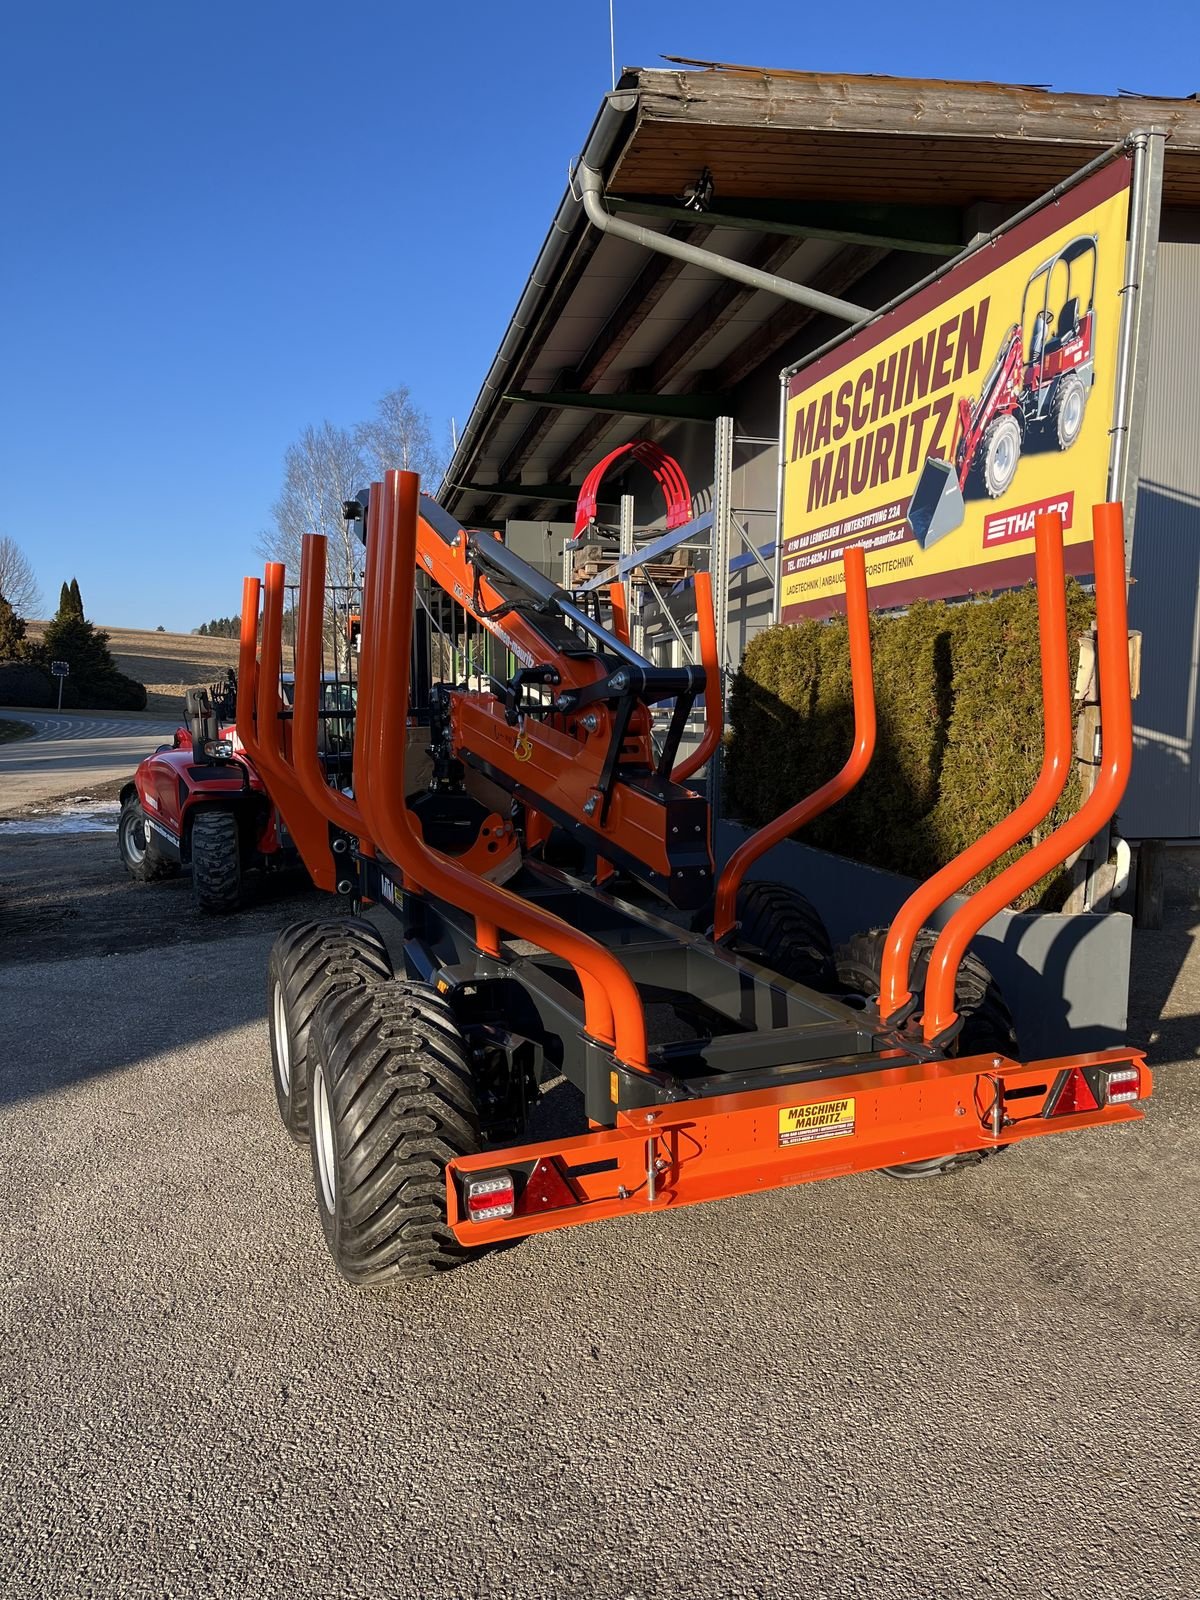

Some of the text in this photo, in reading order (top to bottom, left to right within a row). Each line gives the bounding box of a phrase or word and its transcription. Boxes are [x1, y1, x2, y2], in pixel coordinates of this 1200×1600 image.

[791, 296, 991, 463] MASCHINEN
[806, 392, 954, 513] MAURITZ
[843, 509, 887, 534] UNTERSTIFTUNG
[888, 504, 901, 519] 23A
[786, 580, 819, 596] LADETECHNIK
[865, 555, 914, 576] FORSTTECHNIK
[788, 1101, 848, 1119] MASCHINEN
[795, 1113, 841, 1129] MAURITZ
